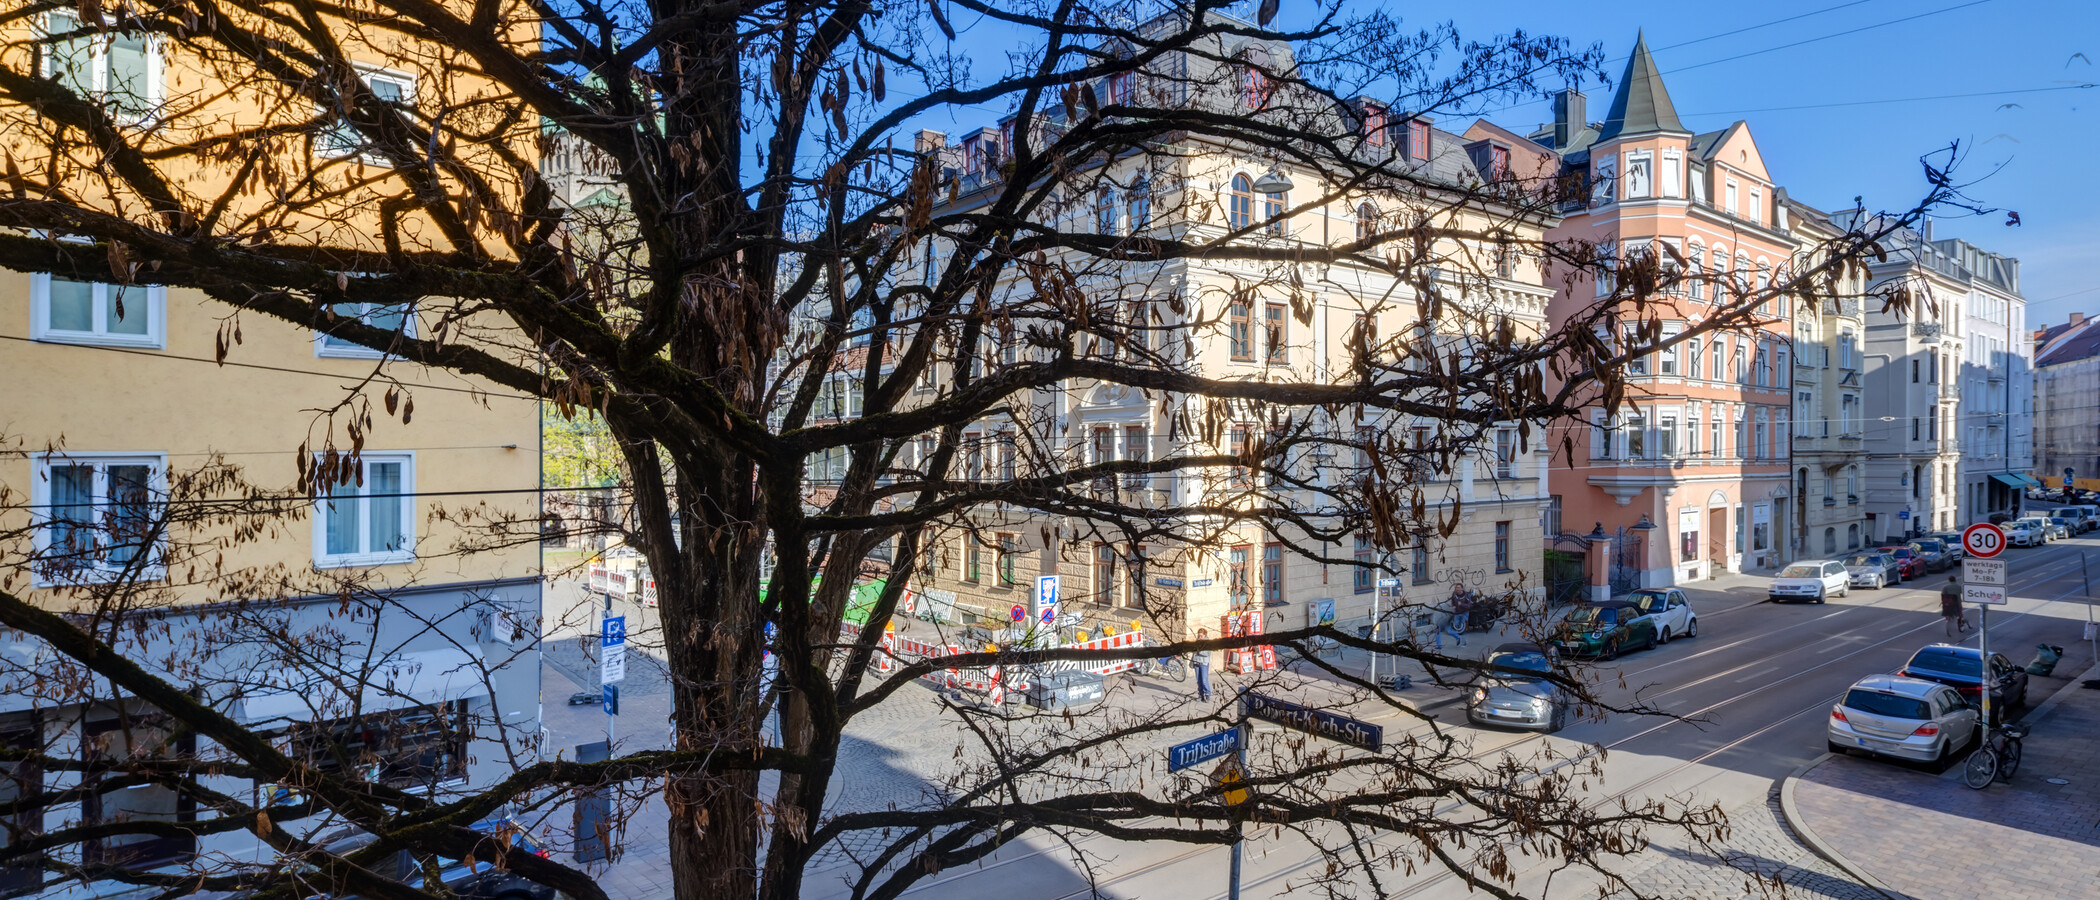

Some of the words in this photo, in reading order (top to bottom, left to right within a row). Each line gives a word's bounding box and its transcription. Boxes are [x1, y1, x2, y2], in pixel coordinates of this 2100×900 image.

[1972, 533, 1996, 549] 30
[1966, 561, 2003, 569] werktags
[1178, 733, 1235, 765] Triftstraße
